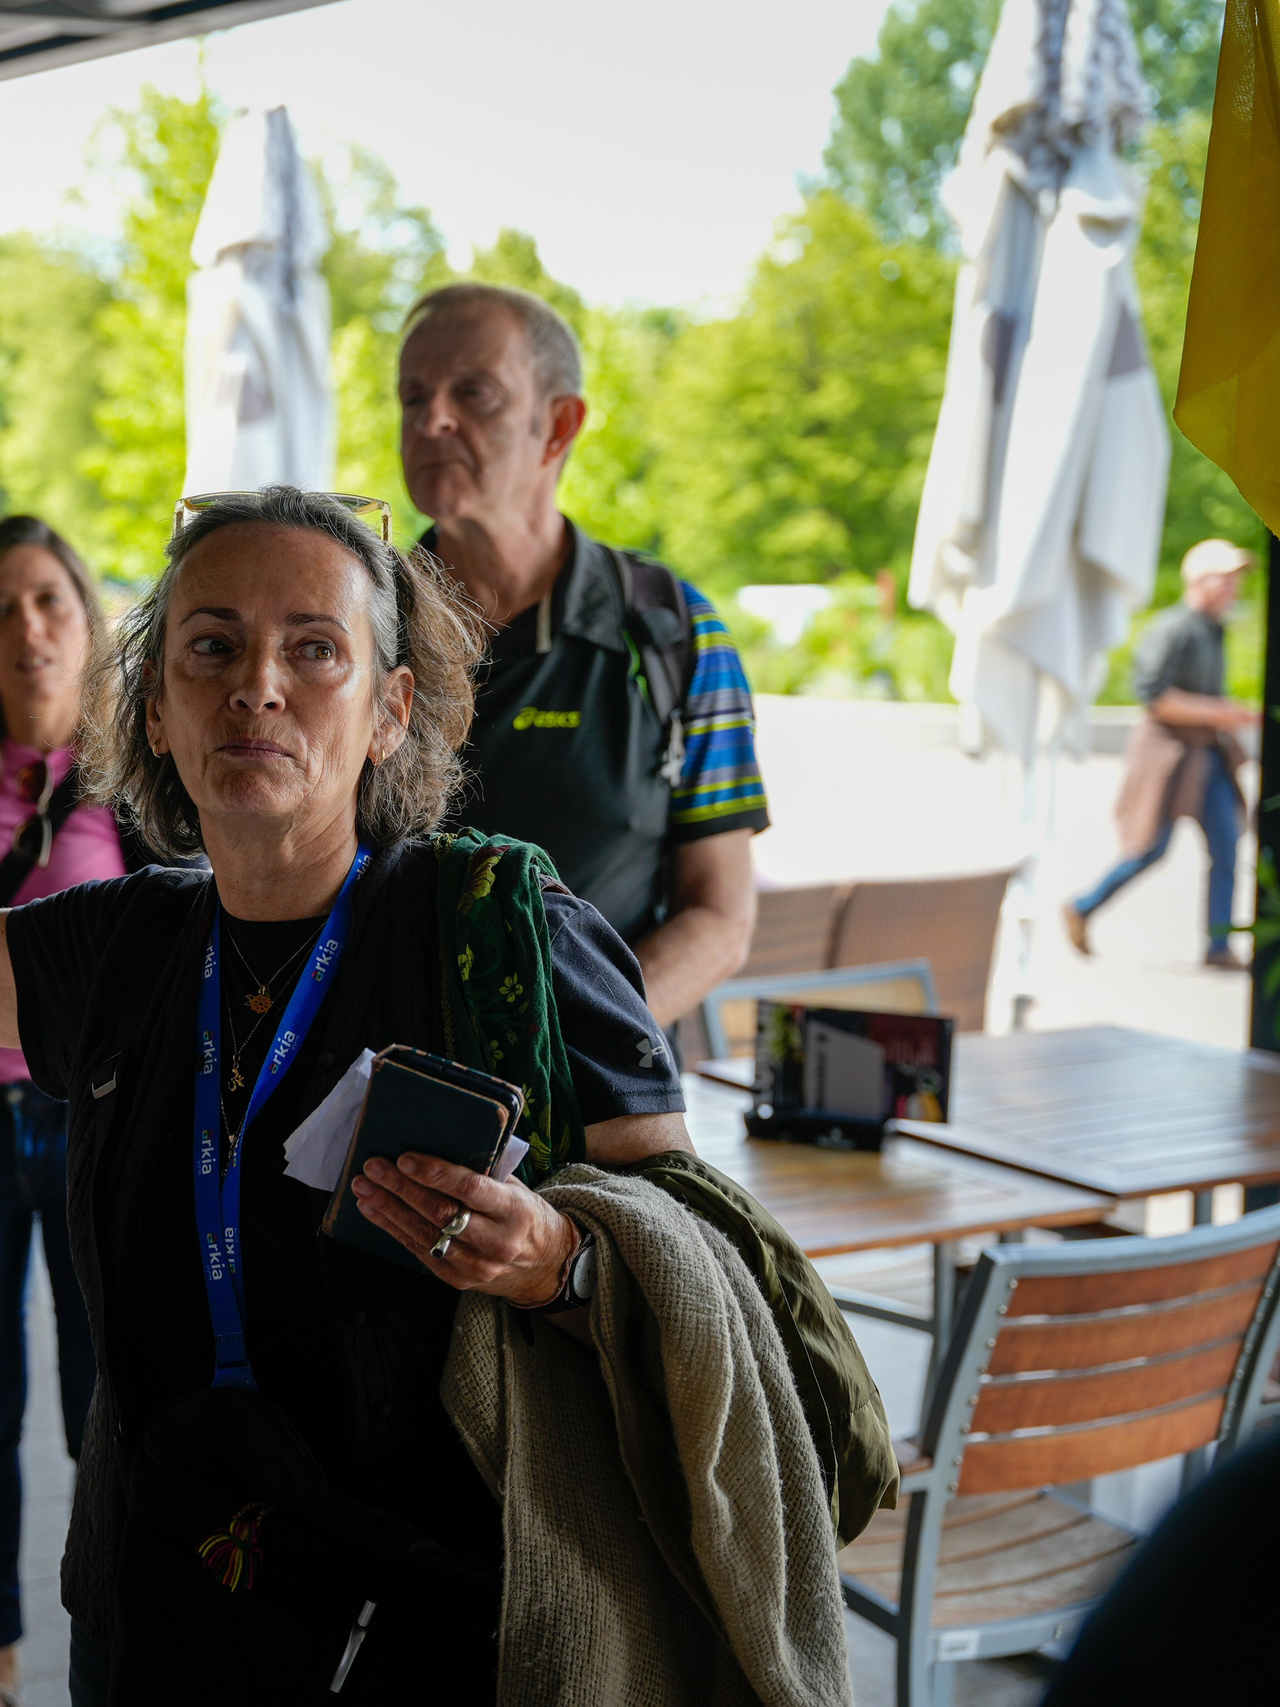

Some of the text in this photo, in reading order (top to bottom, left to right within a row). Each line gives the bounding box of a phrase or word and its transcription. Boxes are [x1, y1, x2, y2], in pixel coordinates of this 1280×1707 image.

[311, 939, 339, 981] arkia
[203, 1030, 218, 1075] arkia
[269, 1030, 296, 1075] arkia
[201, 1129, 217, 1175] arkia
[206, 1232, 226, 1280] arkia
